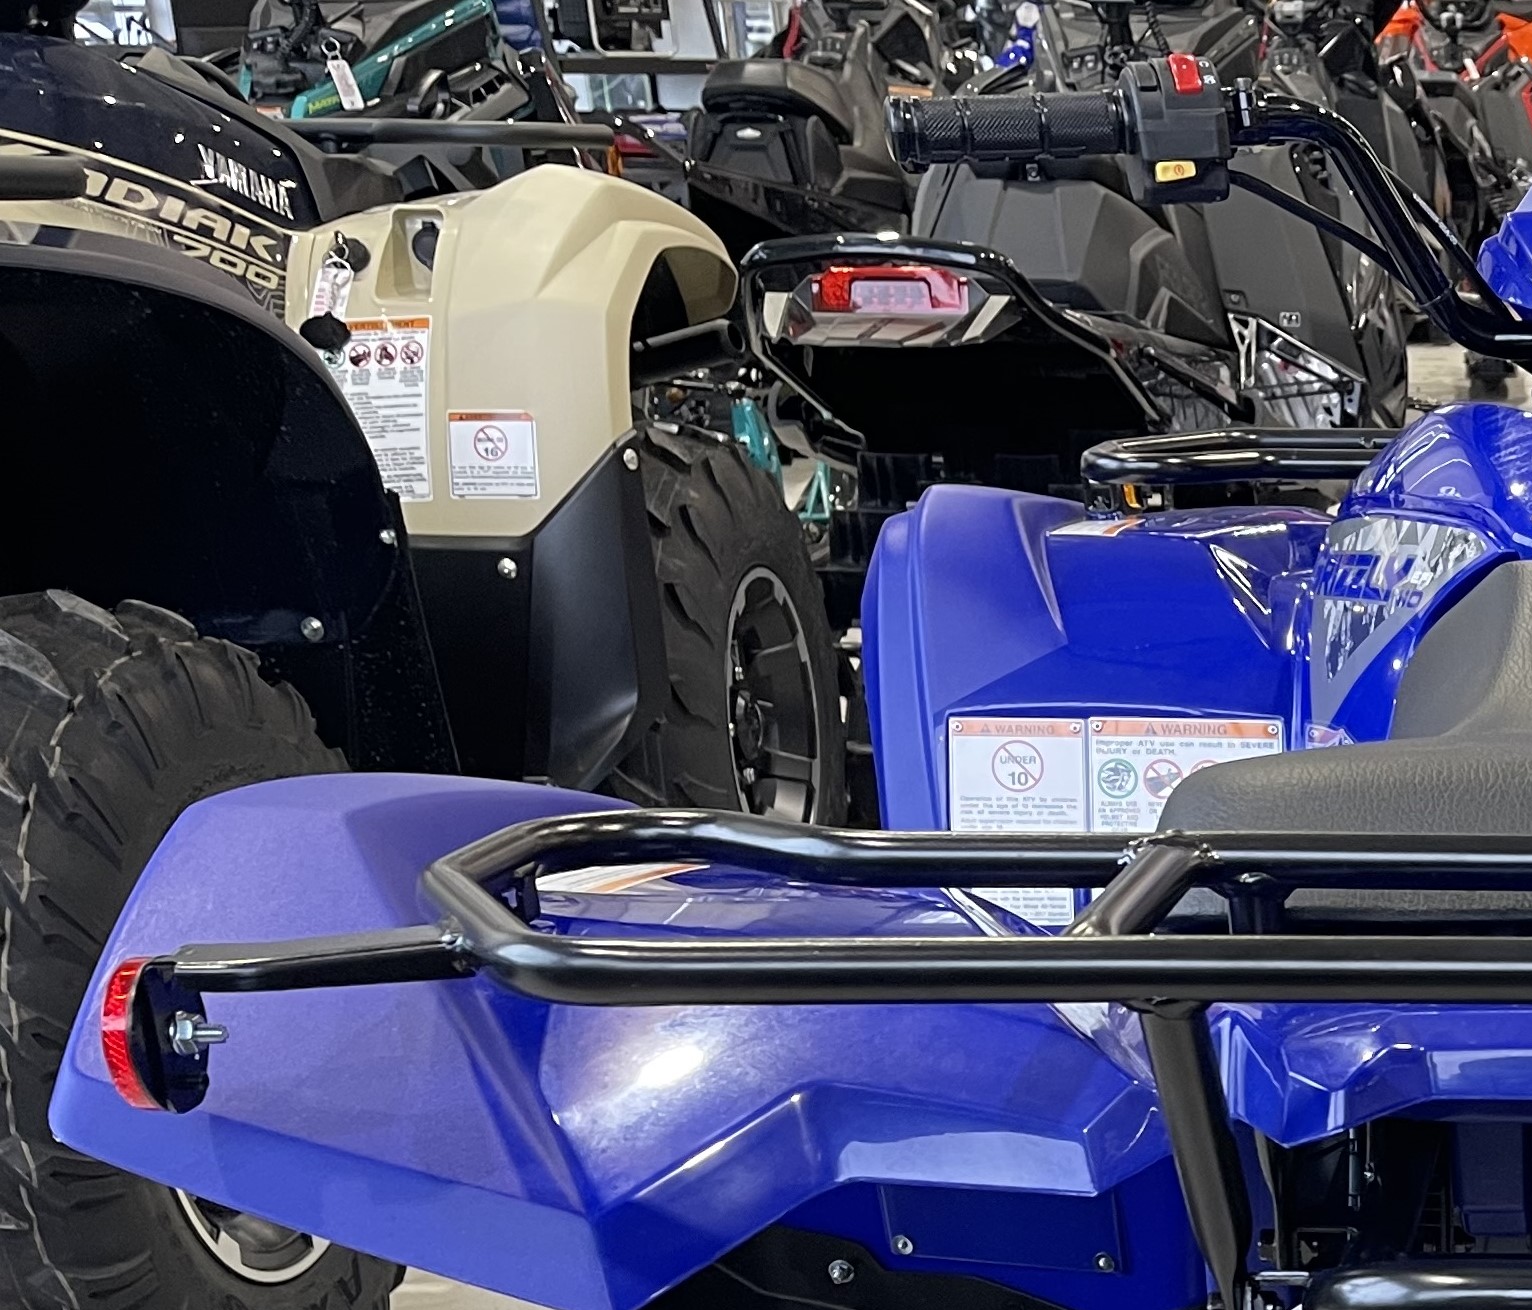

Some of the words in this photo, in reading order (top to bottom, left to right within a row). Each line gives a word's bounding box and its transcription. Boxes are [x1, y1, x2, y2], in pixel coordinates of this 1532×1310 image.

[197, 143, 294, 221] YAMAHA
[173, 234, 280, 291] 700
[995, 725, 1055, 735] WARNING
[1161, 724, 1227, 735] WARNING
[1096, 740, 1133, 748] Improper
[1000, 755, 1037, 765] UNDER
[1008, 771, 1029, 787] 10
